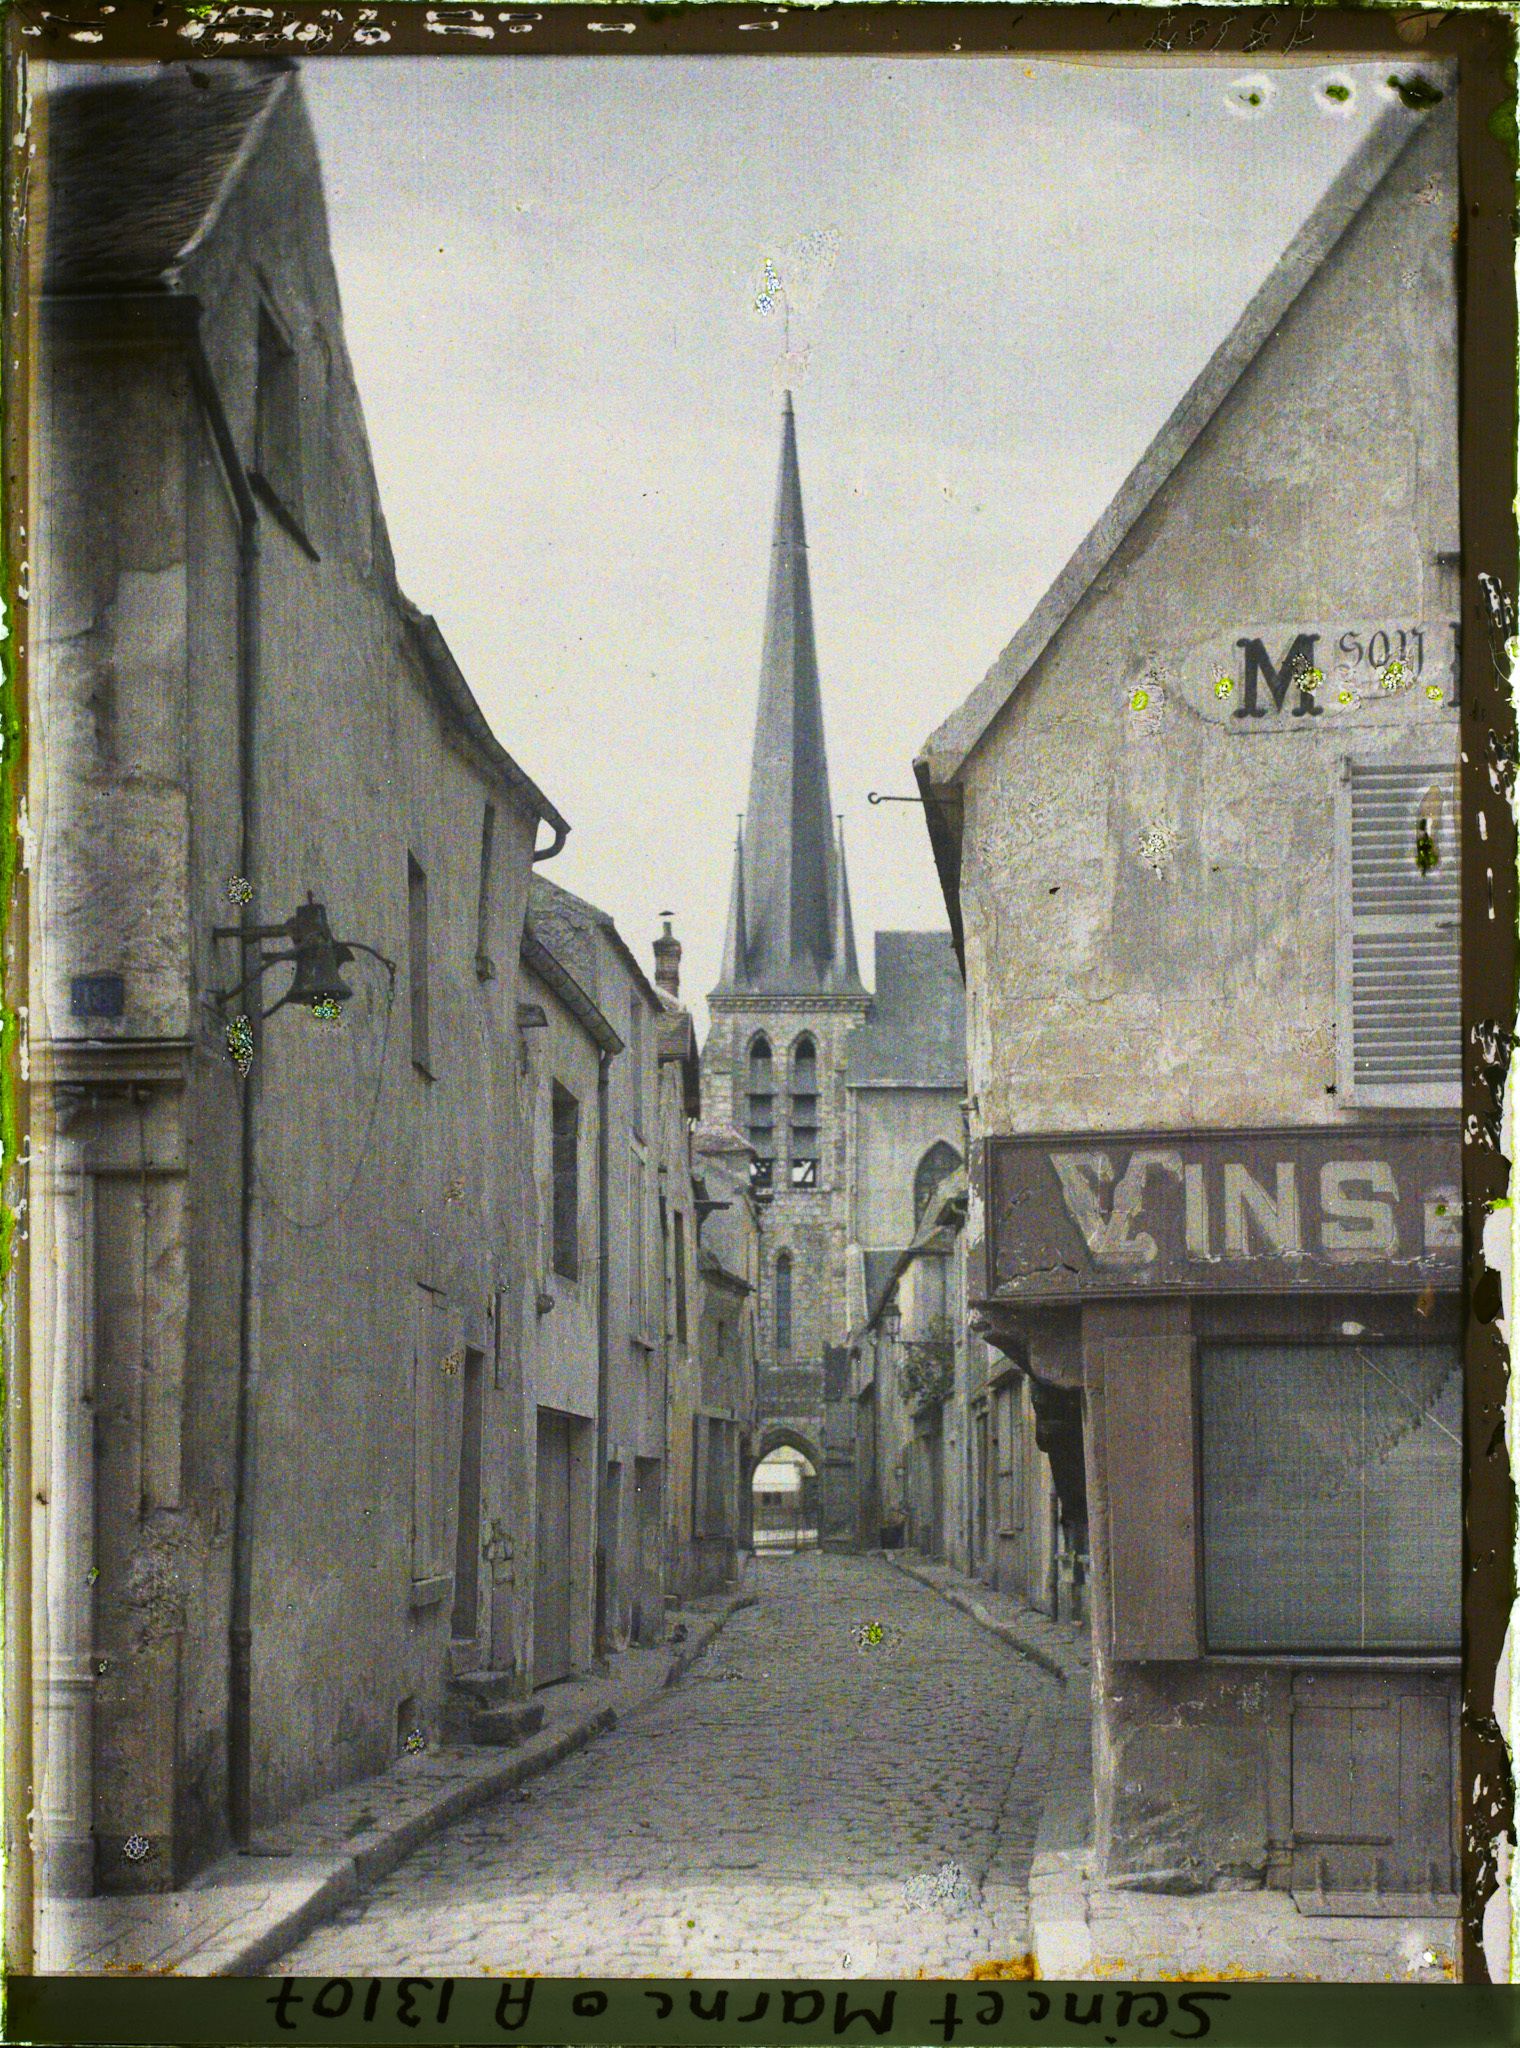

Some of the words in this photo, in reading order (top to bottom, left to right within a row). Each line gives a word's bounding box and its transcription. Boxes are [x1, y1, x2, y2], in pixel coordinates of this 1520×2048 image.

[1049, 1150, 1400, 1262] VINS
[266, 1977, 454, 2029] 13107
[495, 1978, 536, 2030] A
[930, 1991, 1004, 2041] et
